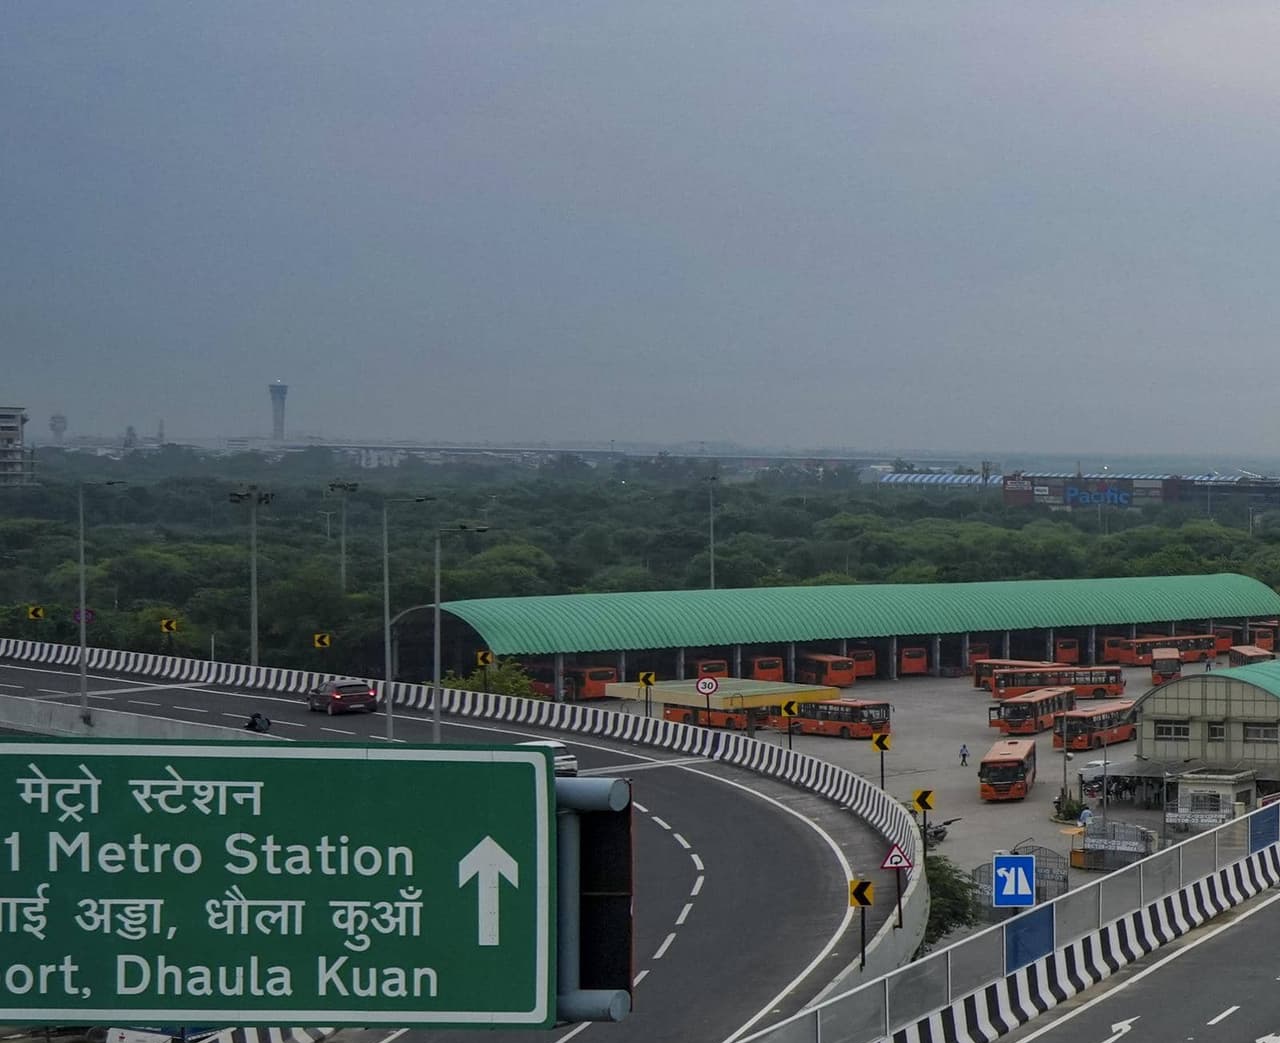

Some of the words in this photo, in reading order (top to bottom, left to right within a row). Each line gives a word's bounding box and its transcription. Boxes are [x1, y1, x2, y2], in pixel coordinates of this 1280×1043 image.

[1066, 486, 1129, 504] Pacific
[701, 681, 714, 690] 30
[16, 763, 102, 823] मेट्रो
[127, 764, 265, 816] स्टेशन
[48, 831, 203, 874] Metro
[225, 833, 415, 878] Station
[0, 883, 50, 940] ाई
[74, 897, 178, 940] अड्डा,
[205, 884, 305, 936] धौला
[330, 888, 424, 951] कुआँ
[116, 954, 294, 997] Dhaula
[317, 956, 439, 998] Kuan
